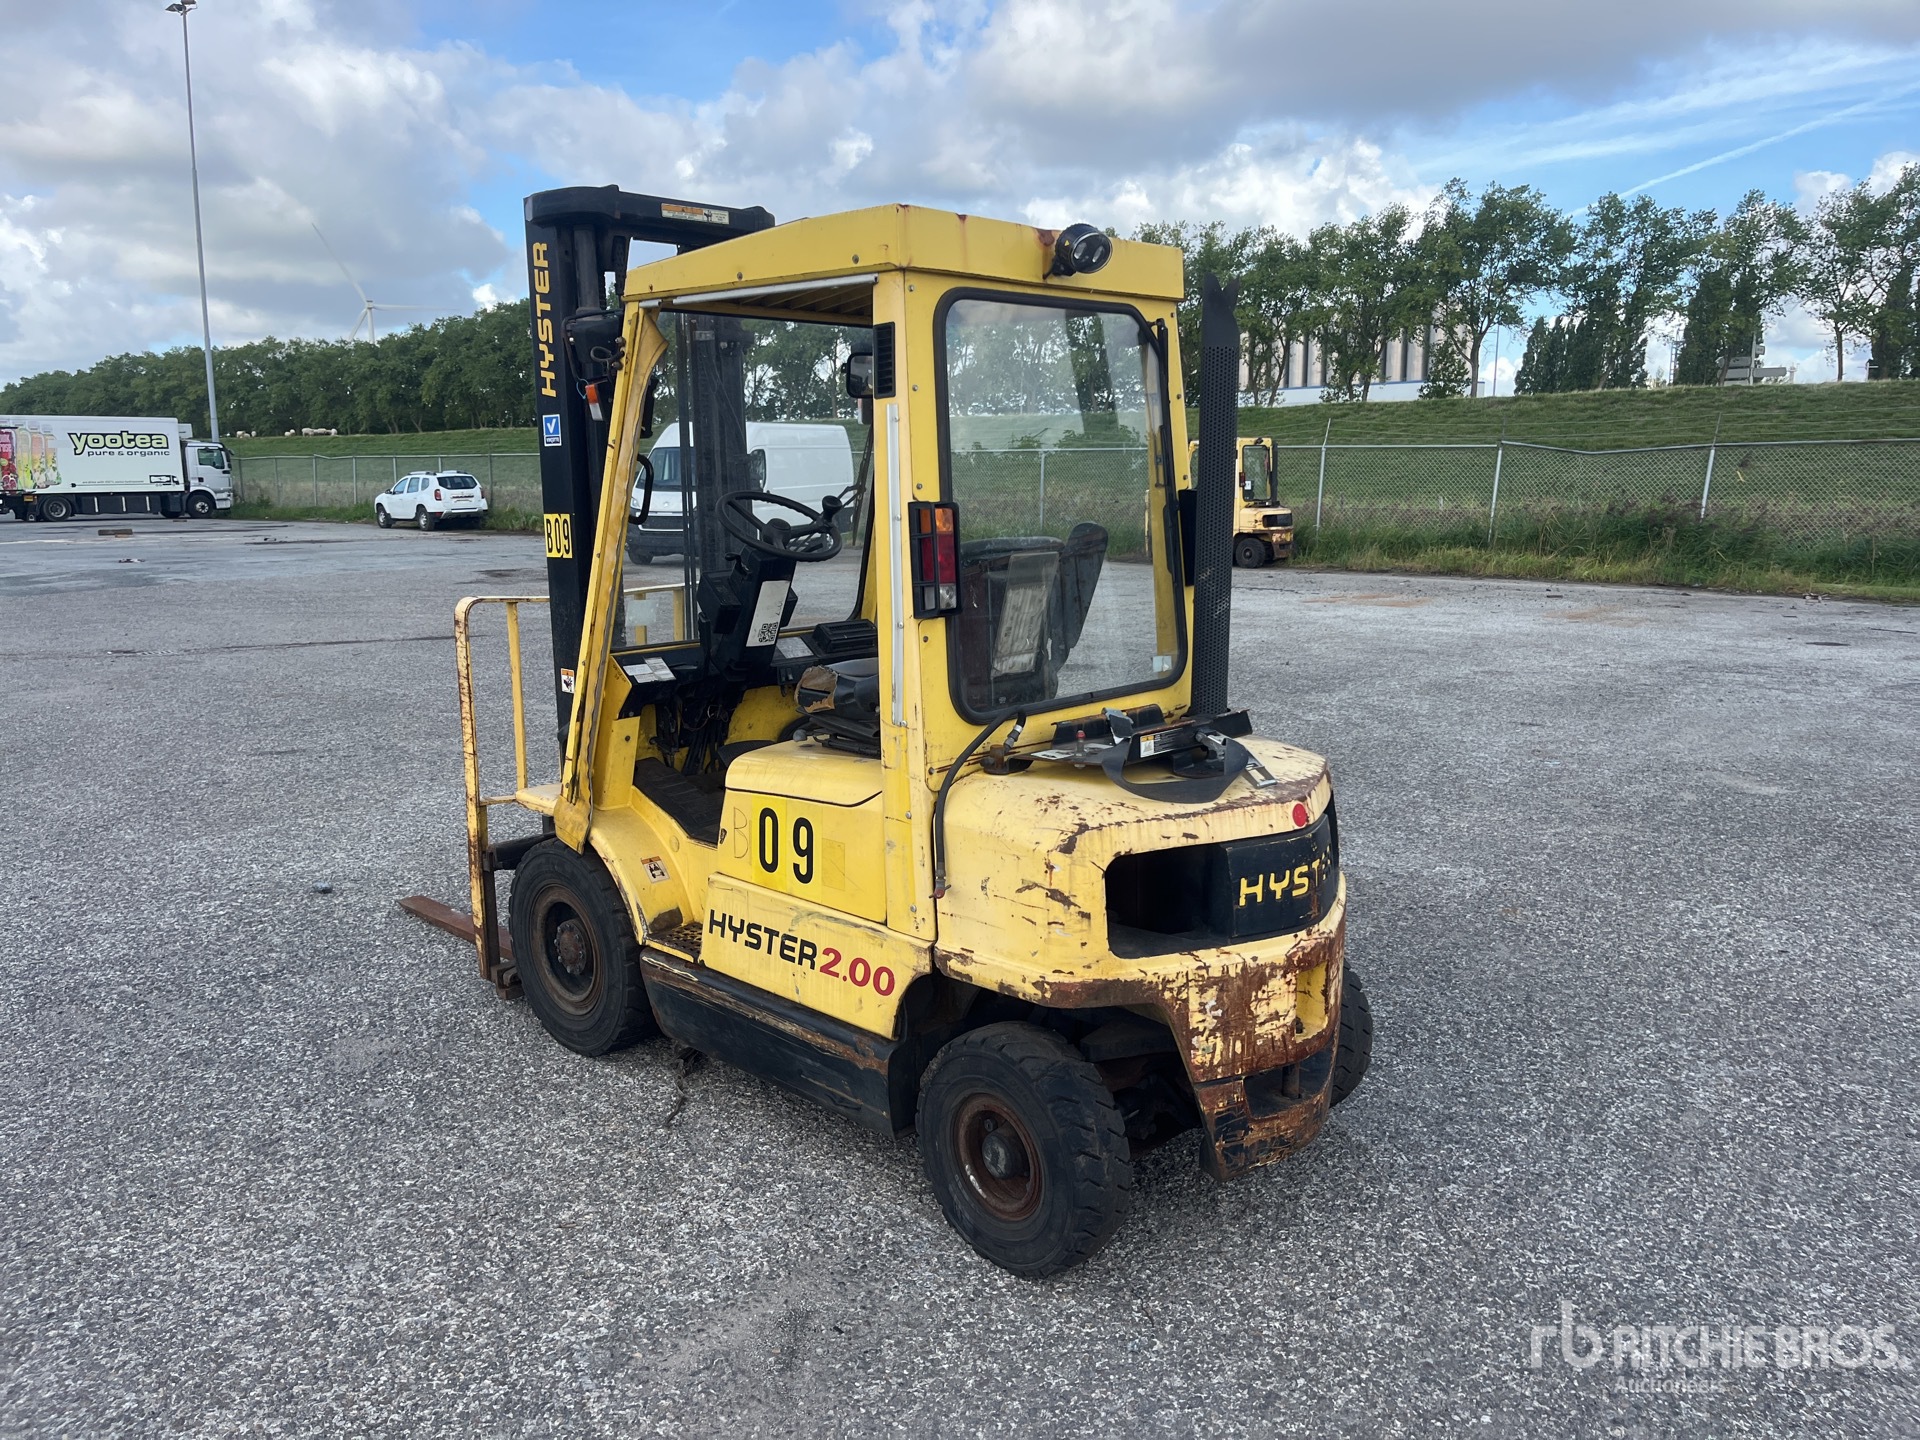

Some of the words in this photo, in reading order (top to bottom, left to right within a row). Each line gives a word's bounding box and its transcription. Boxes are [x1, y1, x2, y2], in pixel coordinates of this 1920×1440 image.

[532, 241, 557, 398] HYSTER
[67, 430, 169, 455] yootea
[545, 517, 572, 556] B09
[708, 908, 818, 971] HYSTER
[819, 946, 896, 997] 2.00
